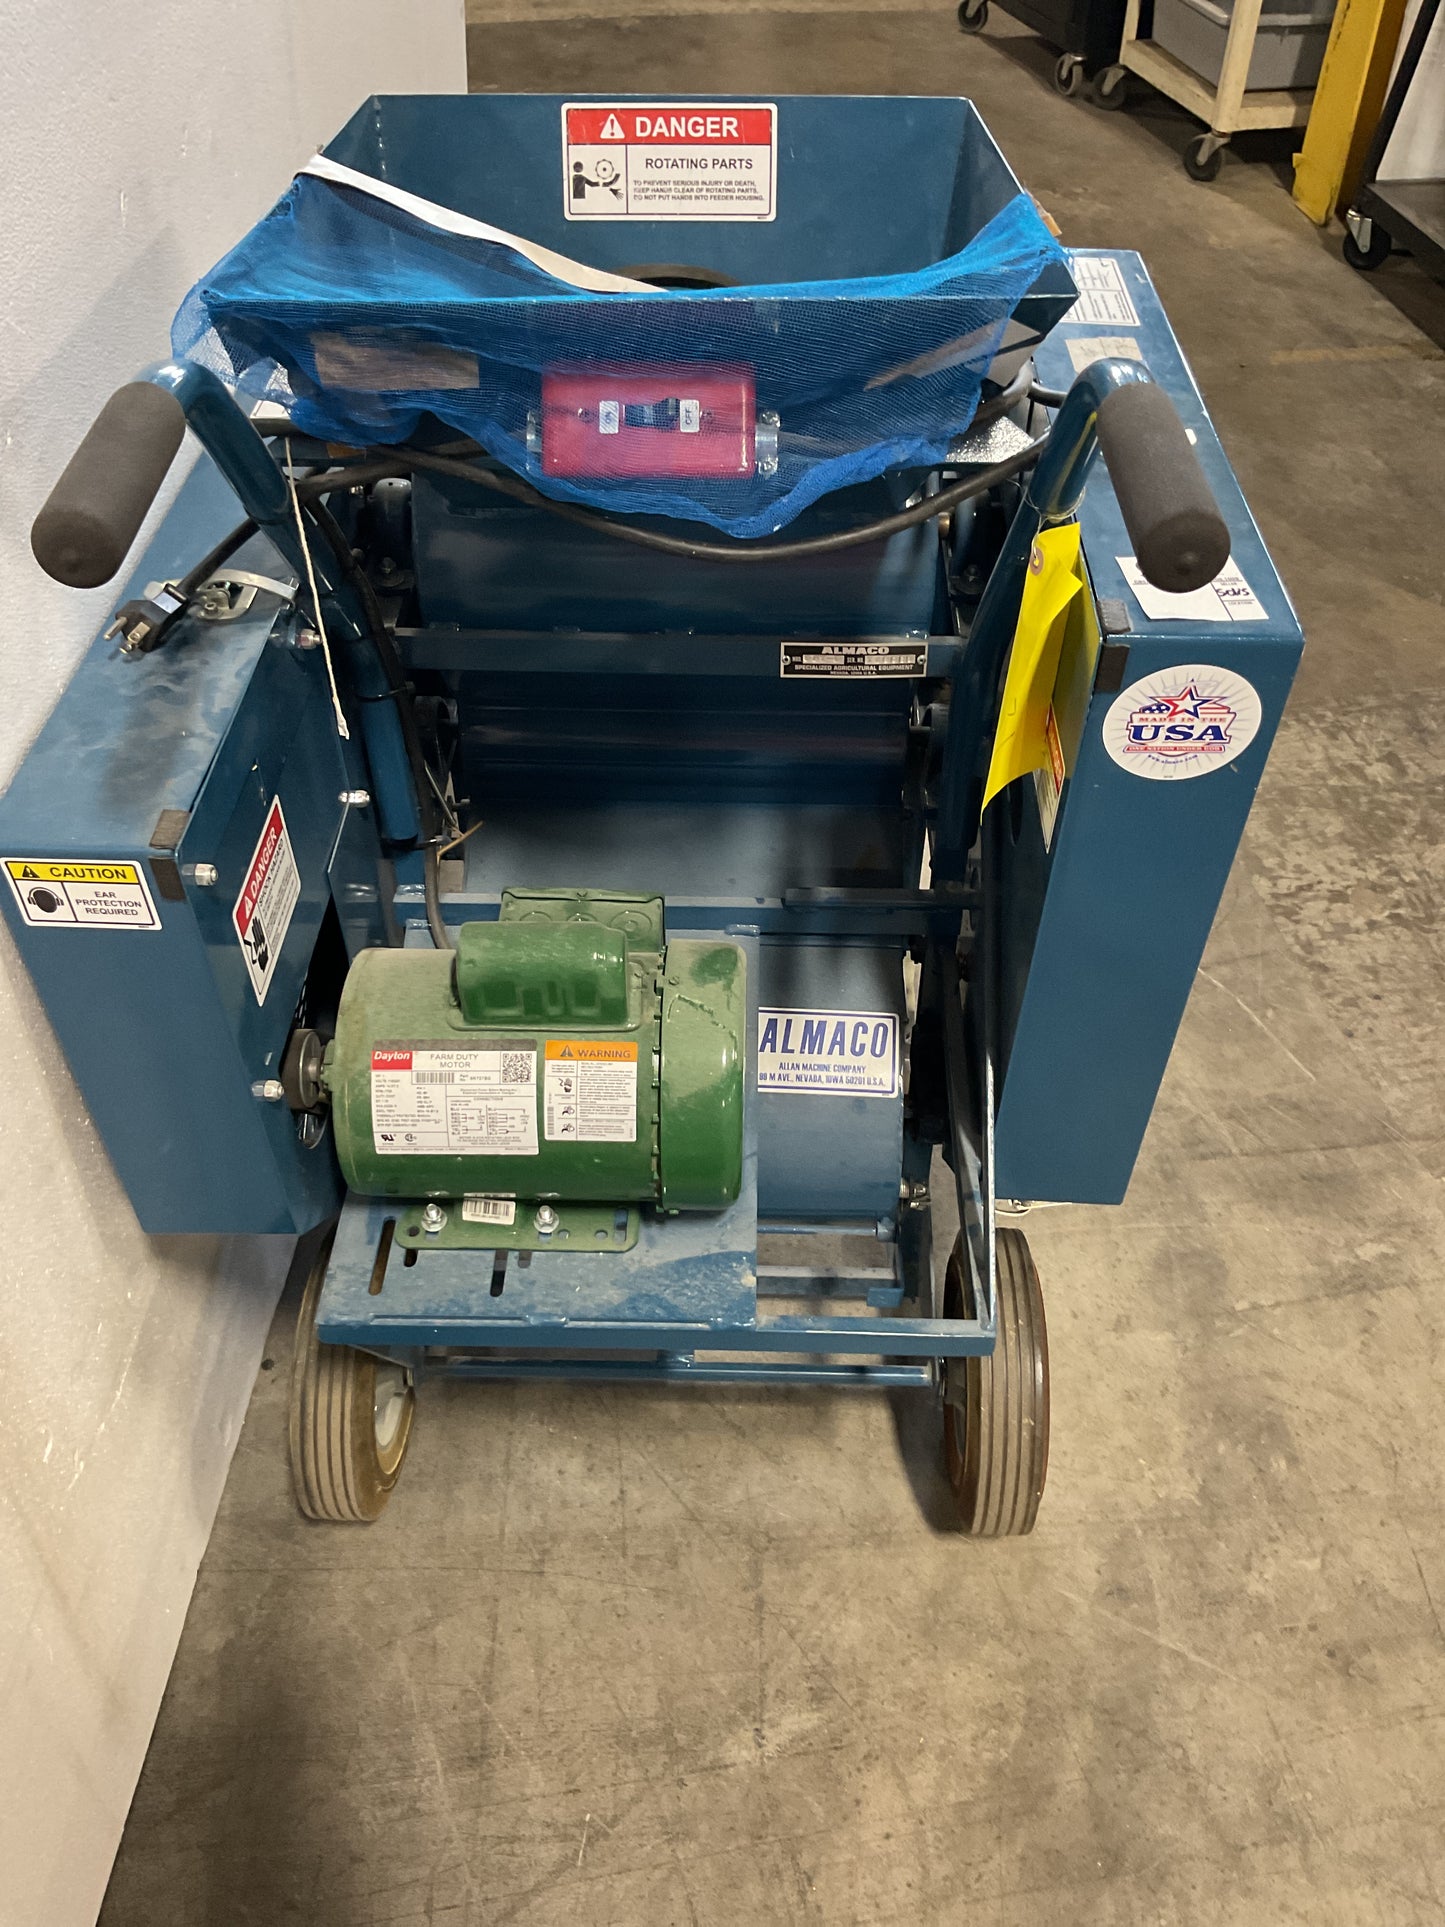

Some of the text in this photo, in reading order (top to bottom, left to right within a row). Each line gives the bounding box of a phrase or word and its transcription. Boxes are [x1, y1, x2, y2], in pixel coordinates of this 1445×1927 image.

[635, 116, 739, 138] DANGER
[645, 158, 753, 170] ROTATING PARTS
[821, 646, 890, 655] ALMACO
[1130, 724, 1228, 741] USA
[250, 827, 277, 899] DANGER
[49, 866, 127, 880] CAUTION
[94, 891, 117, 899] EAR
[75, 899, 142, 908] PROTECTION
[85, 907, 139, 916] REQUIRED
[759, 1017, 889, 1058] ALMACO
[374, 1051, 410, 1062] Dayton
[578, 1050, 631, 1058] WARNING
[779, 1062, 867, 1074] ALLAN MACHINE COMPANY
[769, 1073, 776, 1081] M
[825, 1075, 844, 1084] IOWA
